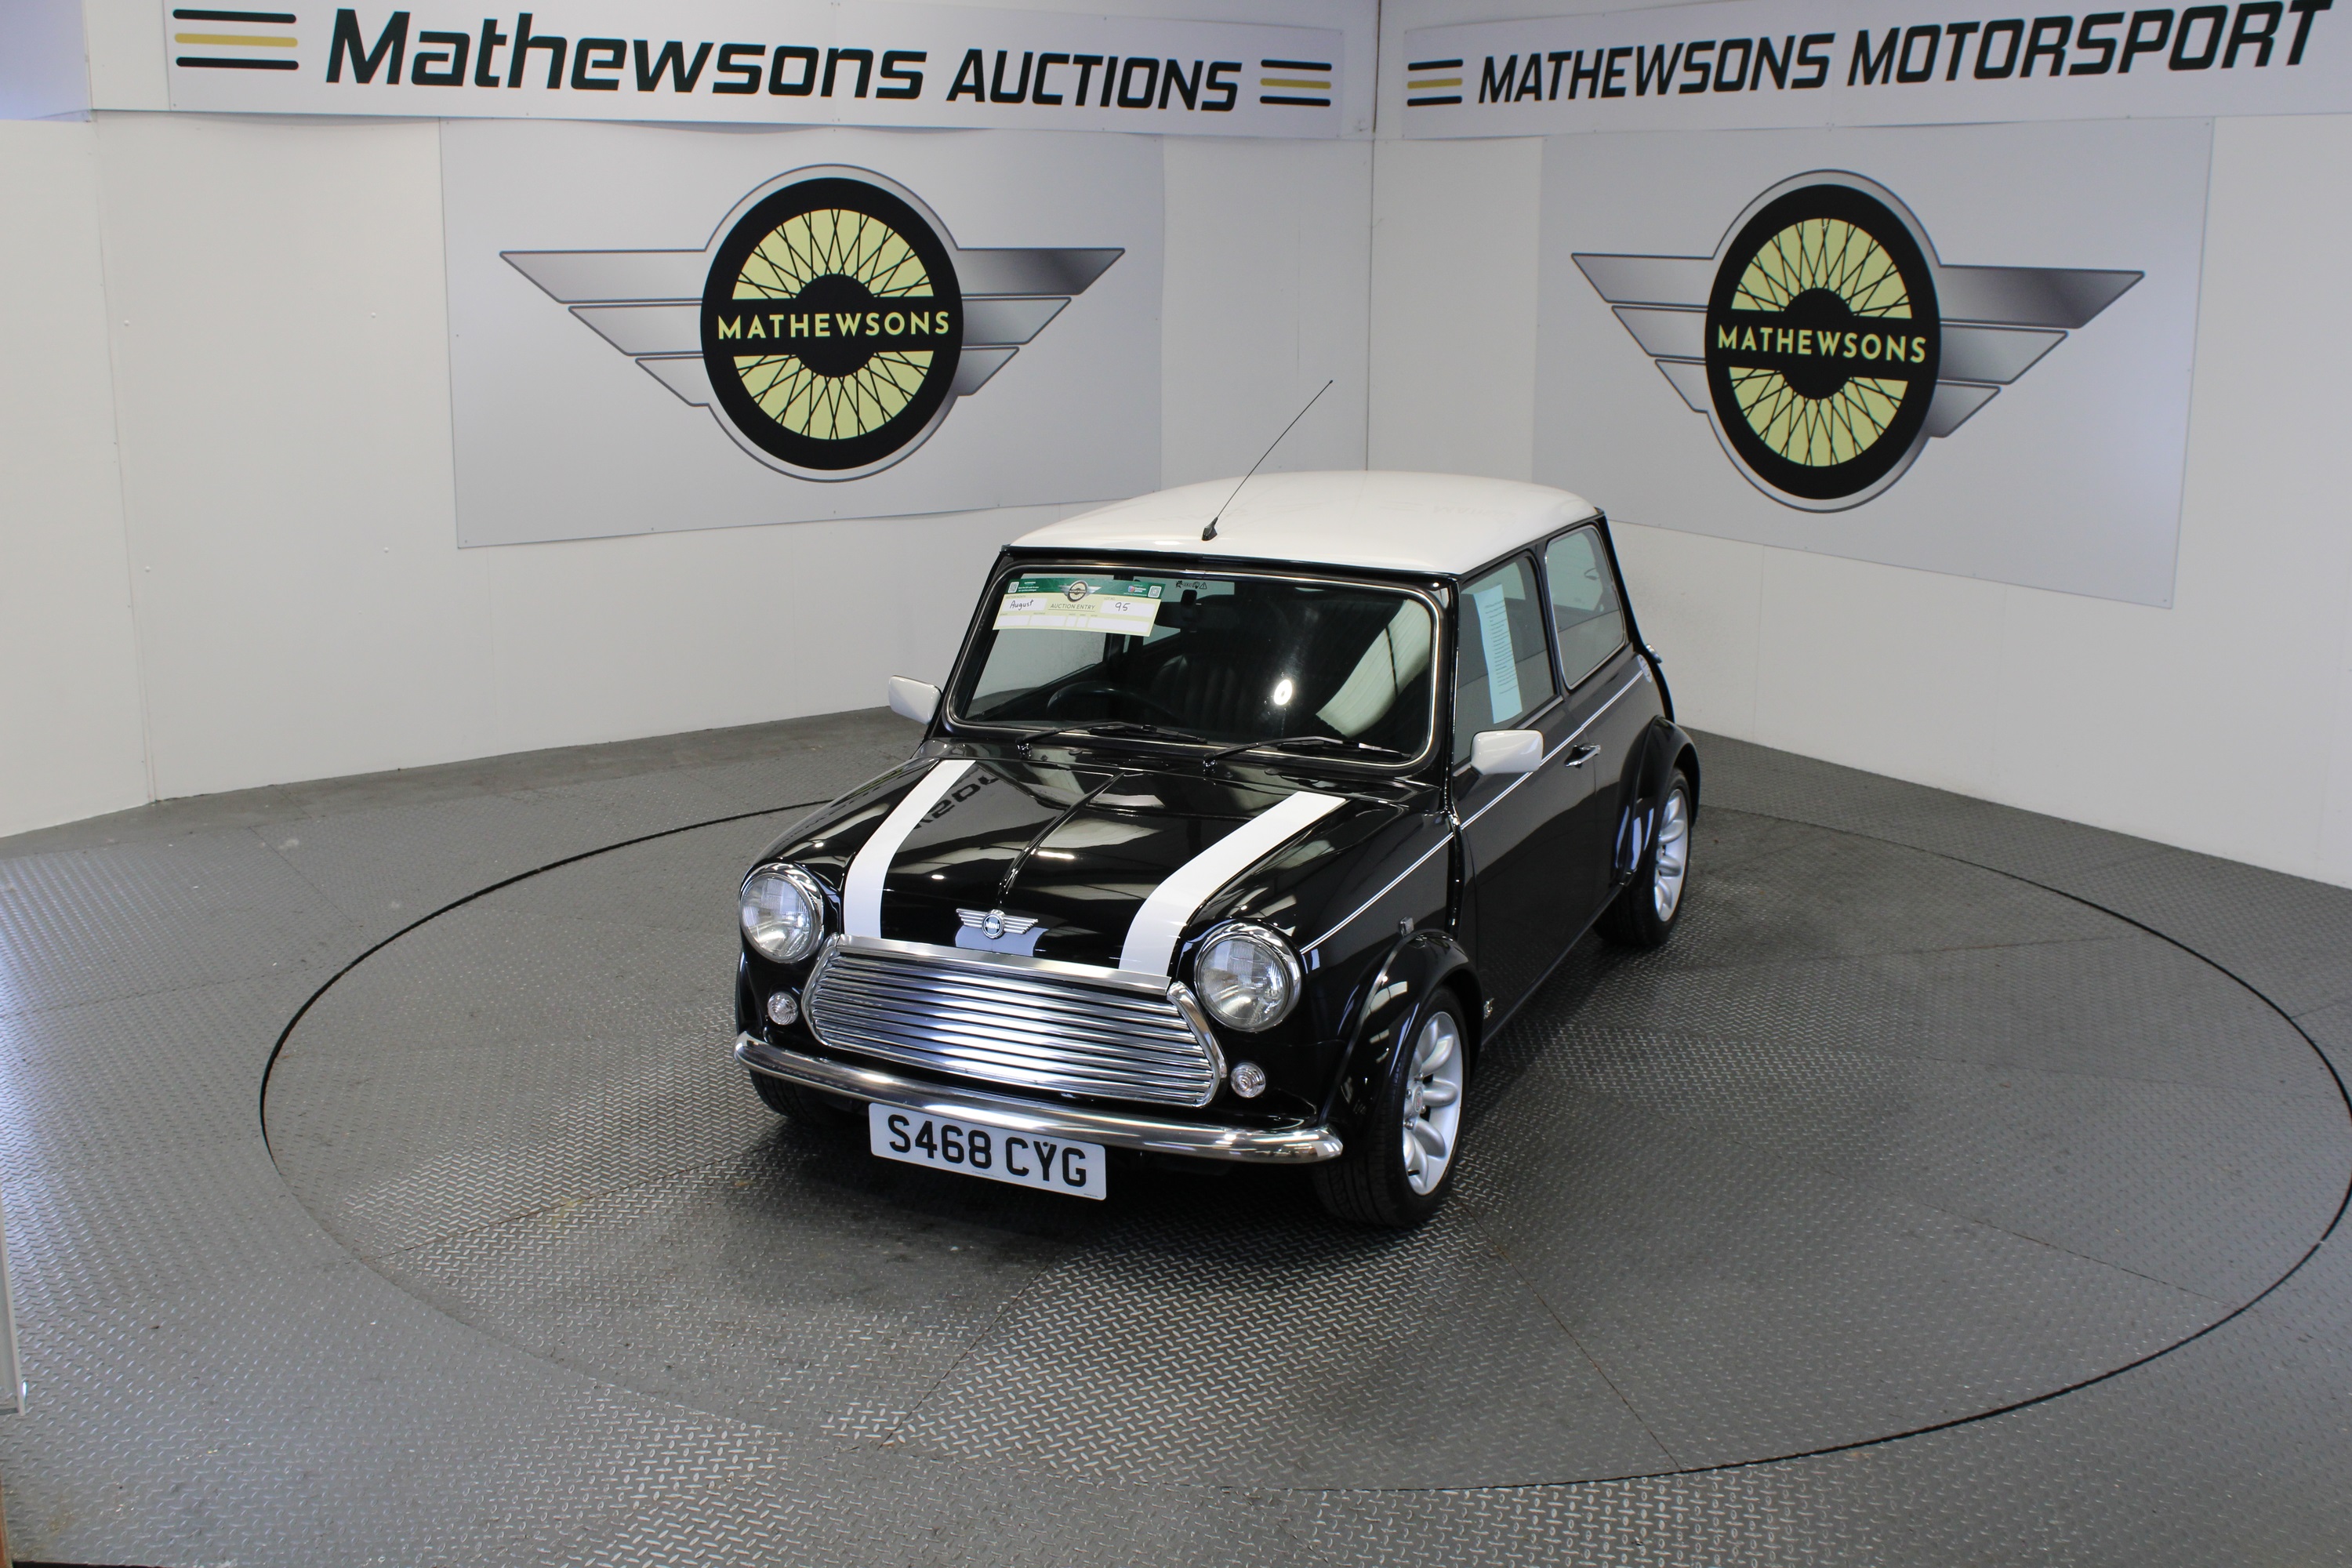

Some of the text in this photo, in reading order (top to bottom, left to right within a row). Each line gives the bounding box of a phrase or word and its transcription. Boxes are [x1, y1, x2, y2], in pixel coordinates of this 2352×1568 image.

[325, 8, 1243, 112] Mathewsons AUCTIONS
[1479, 0, 2333, 103] MATHEWSONS MOTORSPORT
[717, 310, 949, 340] MATHEWSONS
[1718, 324, 1926, 364] MATHEWSONS
[1009, 599, 1034, 611] August
[1115, 602, 1131, 612] 95
[985, 920, 1000, 930] MINI
[887, 1114, 1087, 1187] S468 CYG
